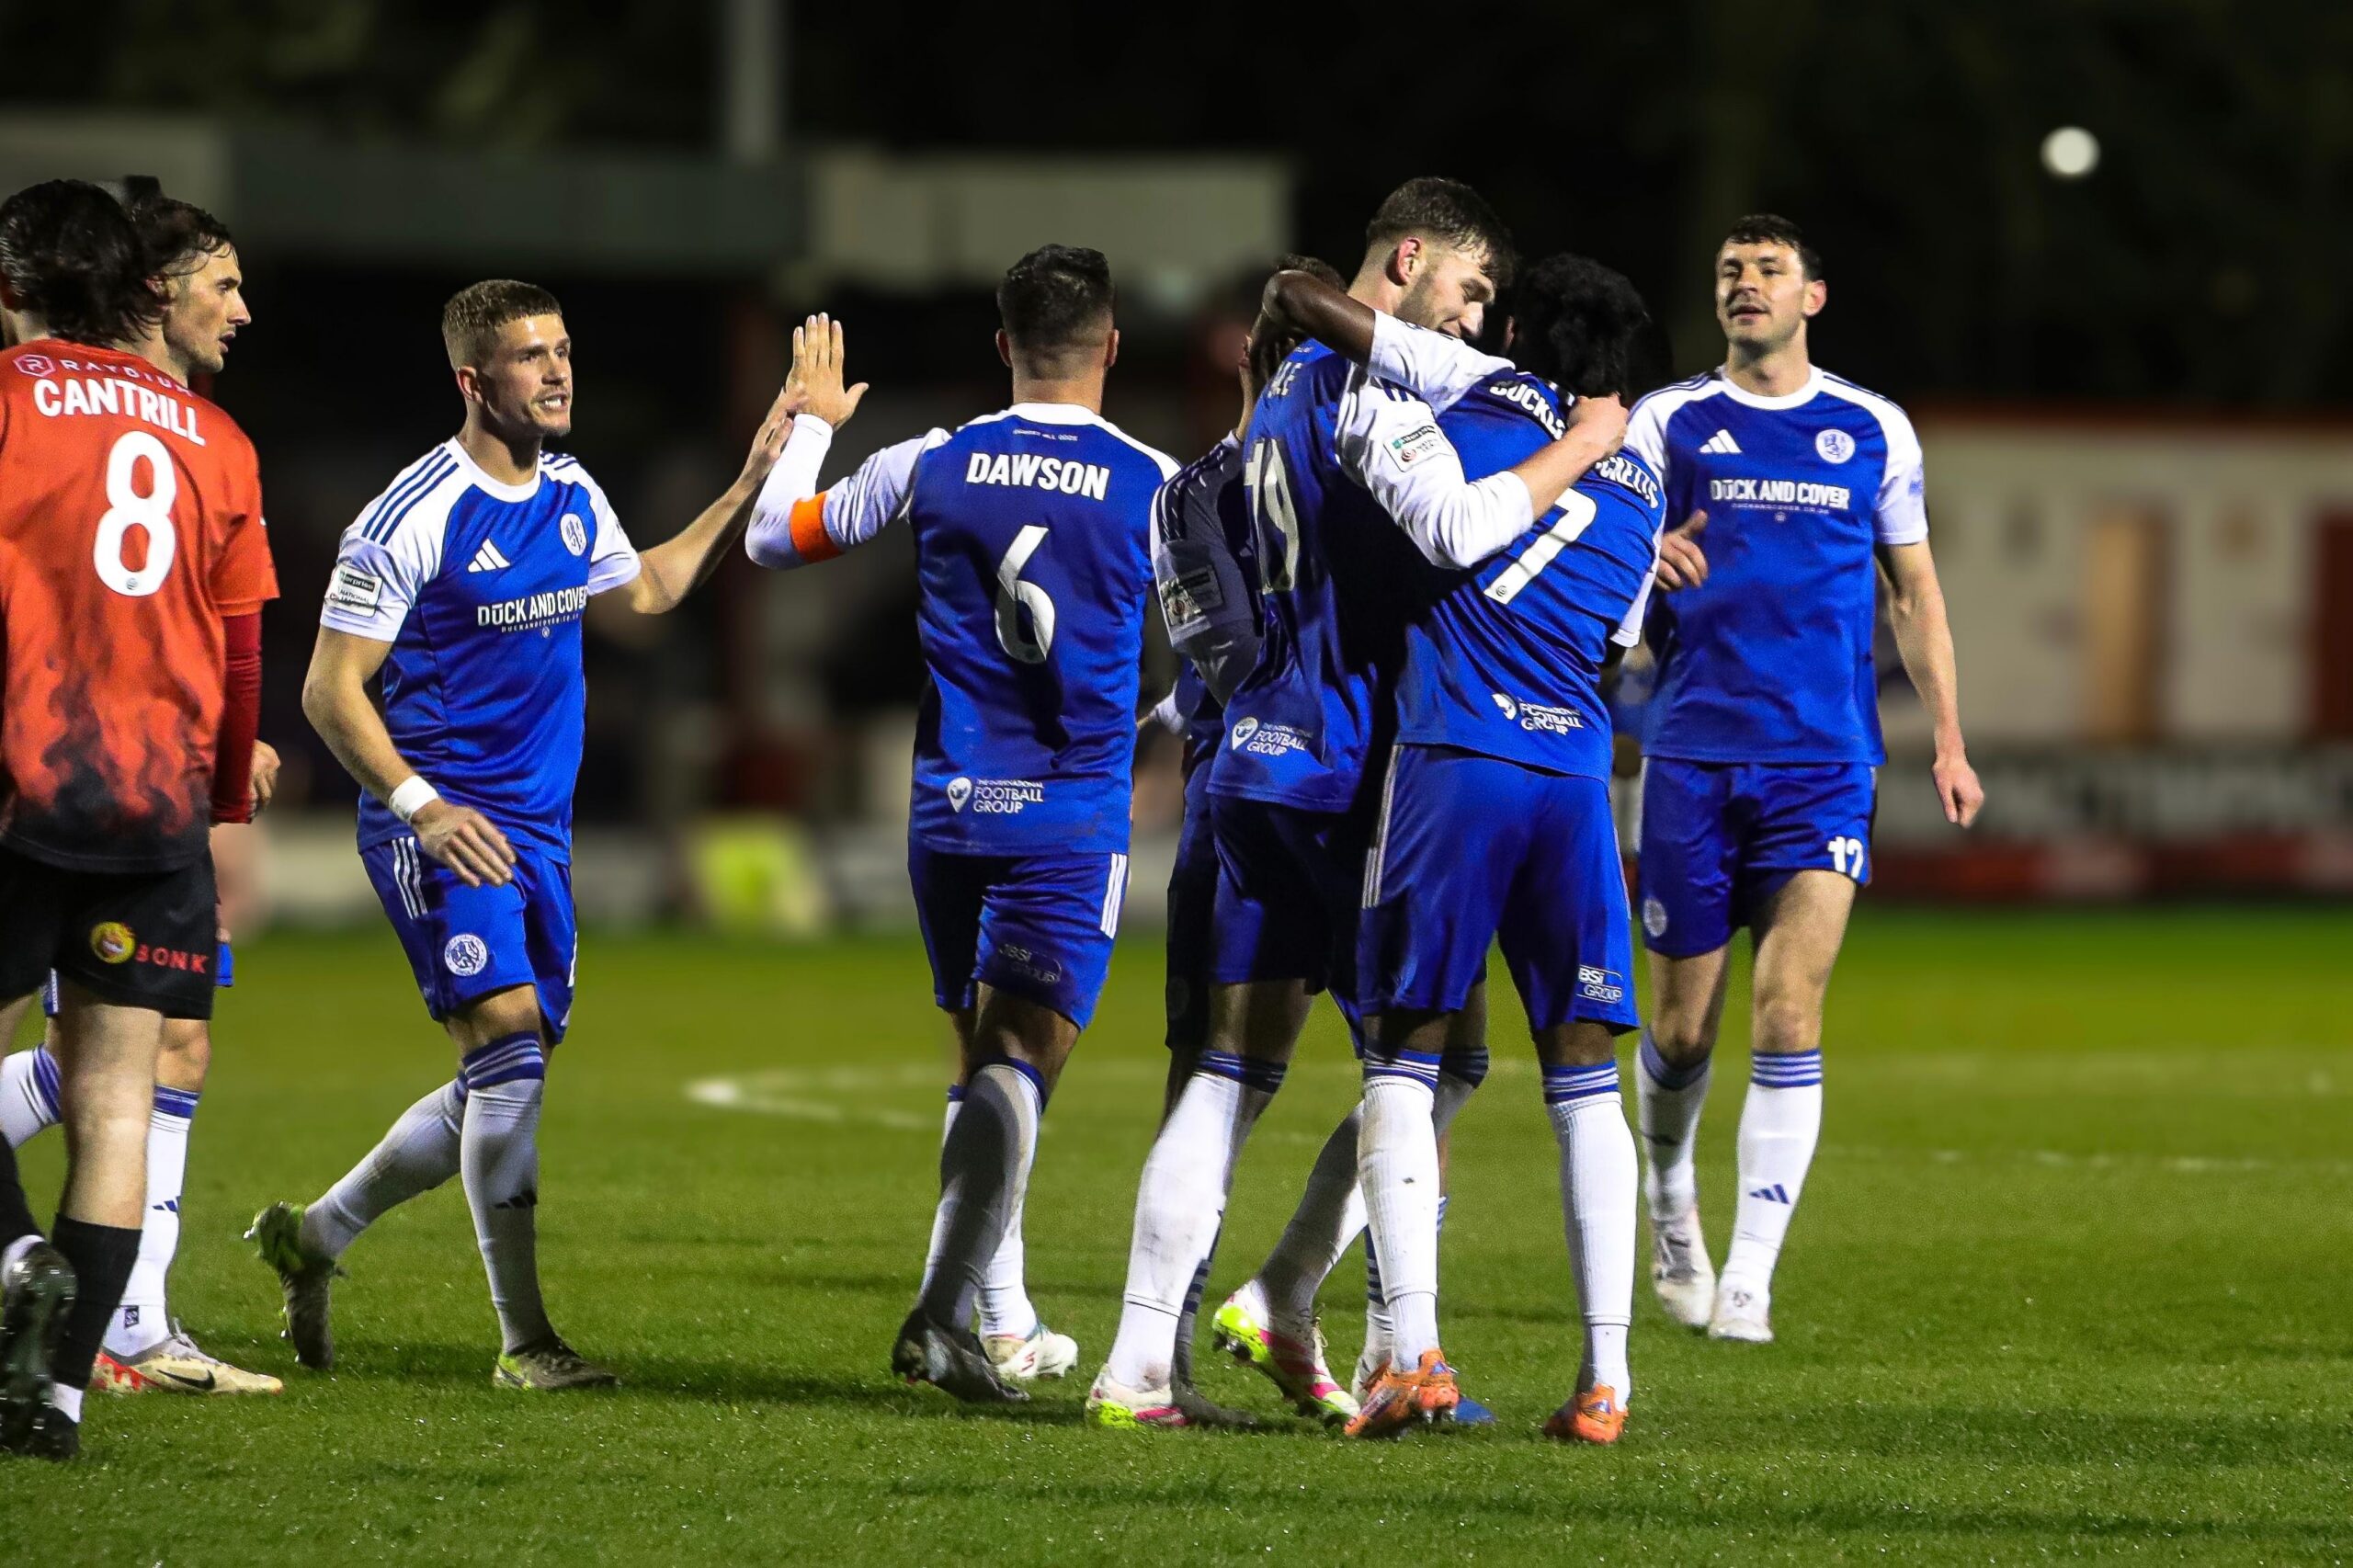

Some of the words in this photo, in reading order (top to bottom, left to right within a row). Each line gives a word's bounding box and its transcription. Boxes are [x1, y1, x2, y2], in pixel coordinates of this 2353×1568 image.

[33, 378, 206, 447] CANTRILL
[966, 452, 1110, 501] DAWSON
[1759, 480, 1796, 503] AND
[1797, 483, 1850, 510] COVER
[94, 430, 177, 597] 8
[1483, 487, 1597, 605] 7
[529, 592, 556, 621] AND
[994, 525, 1056, 665] 6
[973, 800, 1024, 814] GROUP
[974, 786, 1044, 802] FOOTBALL
[135, 943, 210, 974] BONK
